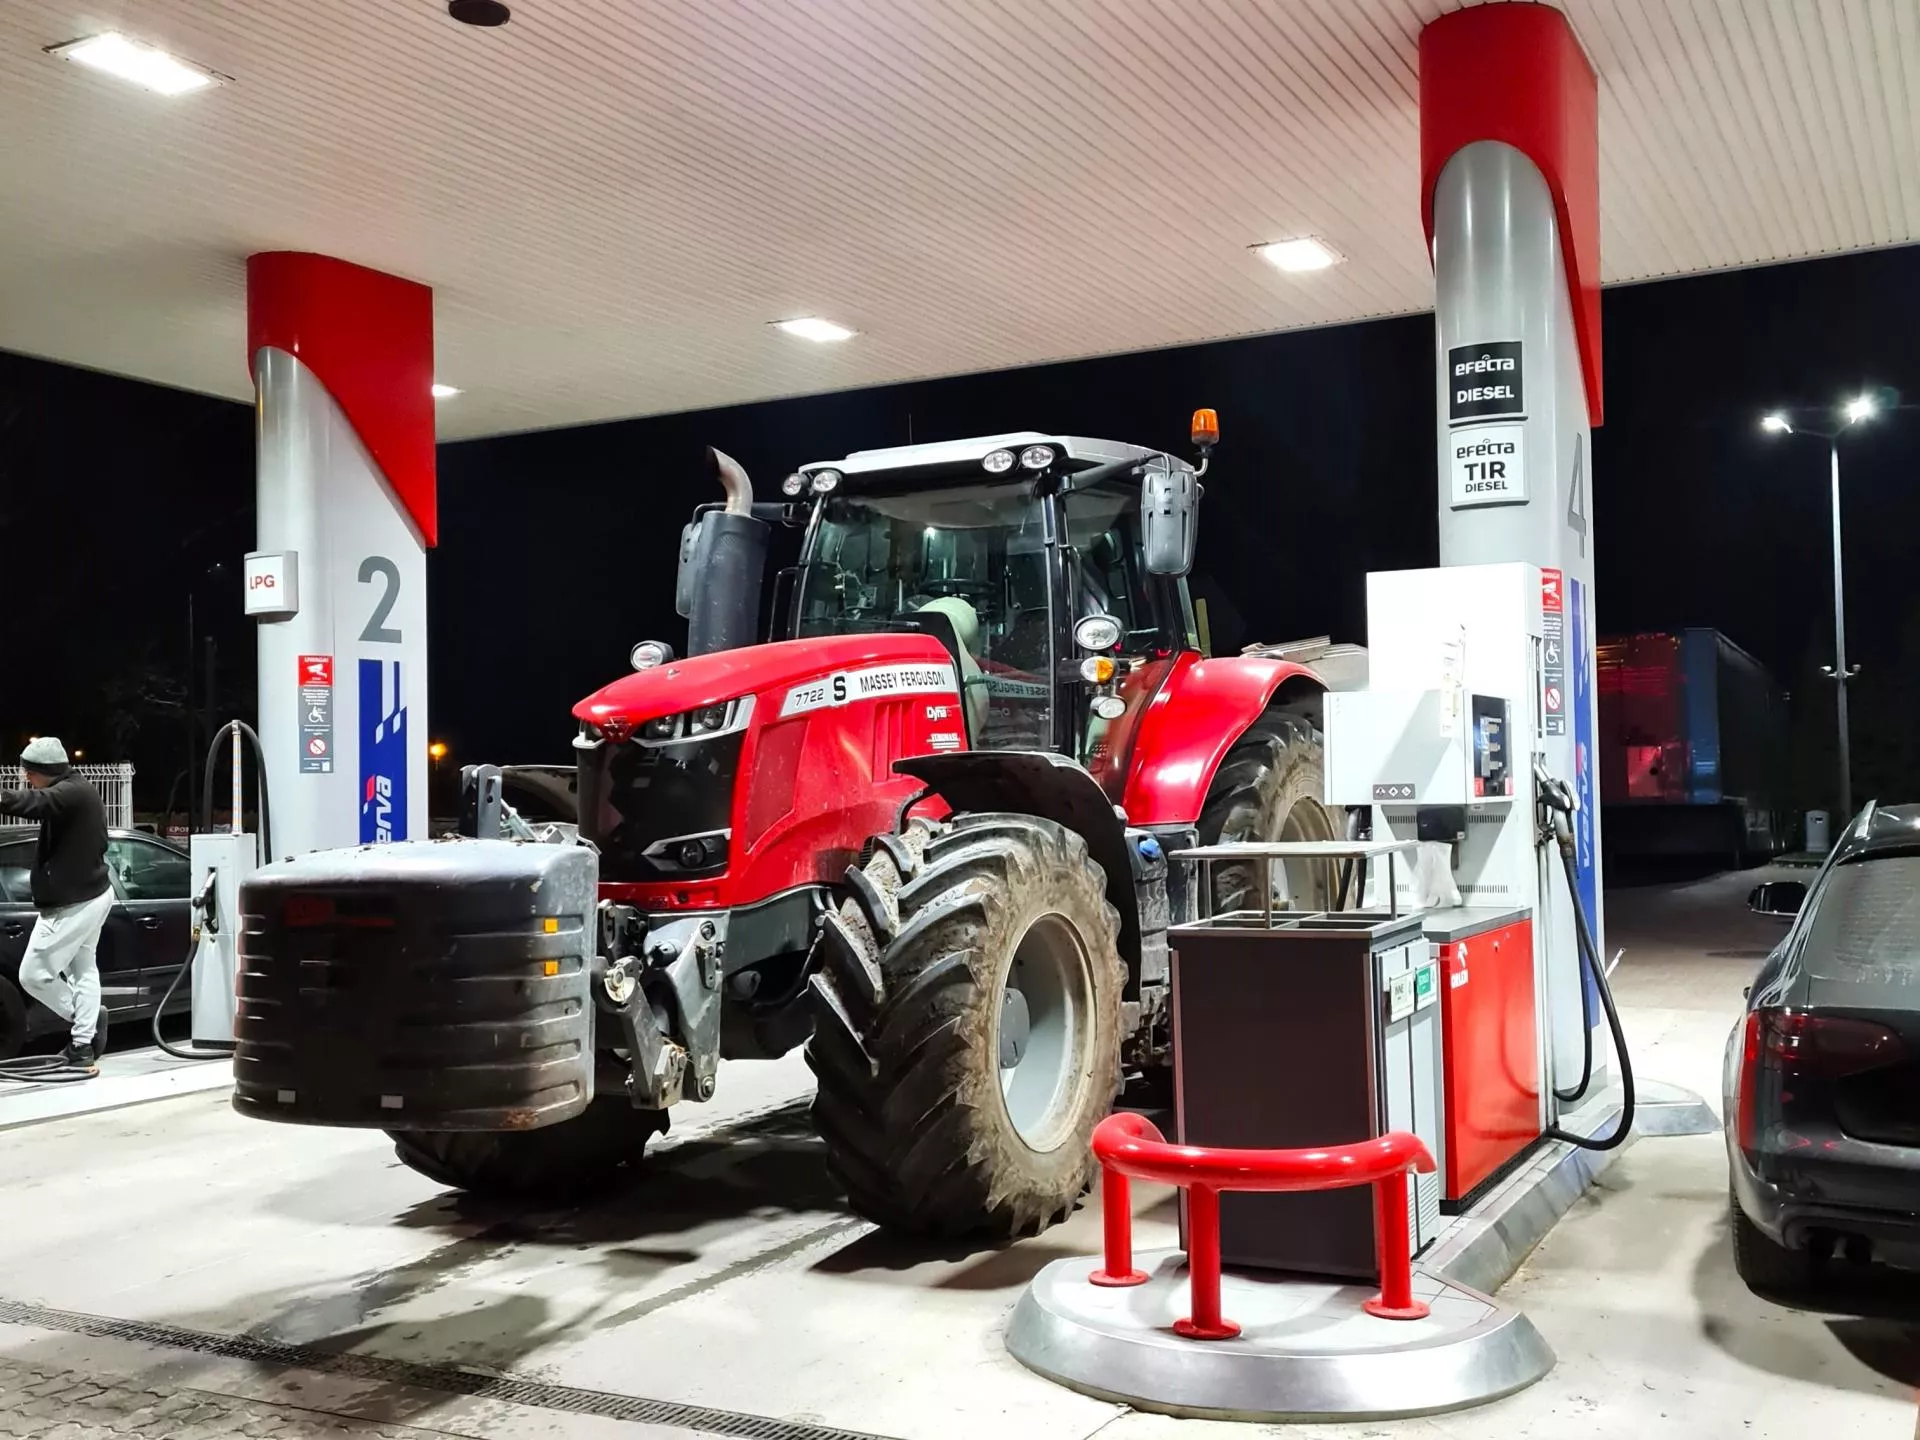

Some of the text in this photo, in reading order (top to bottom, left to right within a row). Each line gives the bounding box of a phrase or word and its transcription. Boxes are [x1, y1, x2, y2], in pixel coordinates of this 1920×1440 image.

[1455, 356, 1515, 376] efecta
[1457, 385, 1514, 403] DIESEL
[1456, 441, 1515, 459] efecta
[1464, 461, 1506, 481] TIR
[1465, 481, 1508, 493] DIESEL
[1568, 432, 1586, 558] 4
[249, 574, 275, 590] LPG
[357, 556, 402, 644] 2
[795, 671, 946, 706] 7722 S MASSEY FERGUSON
[376, 775, 392, 844] erva
